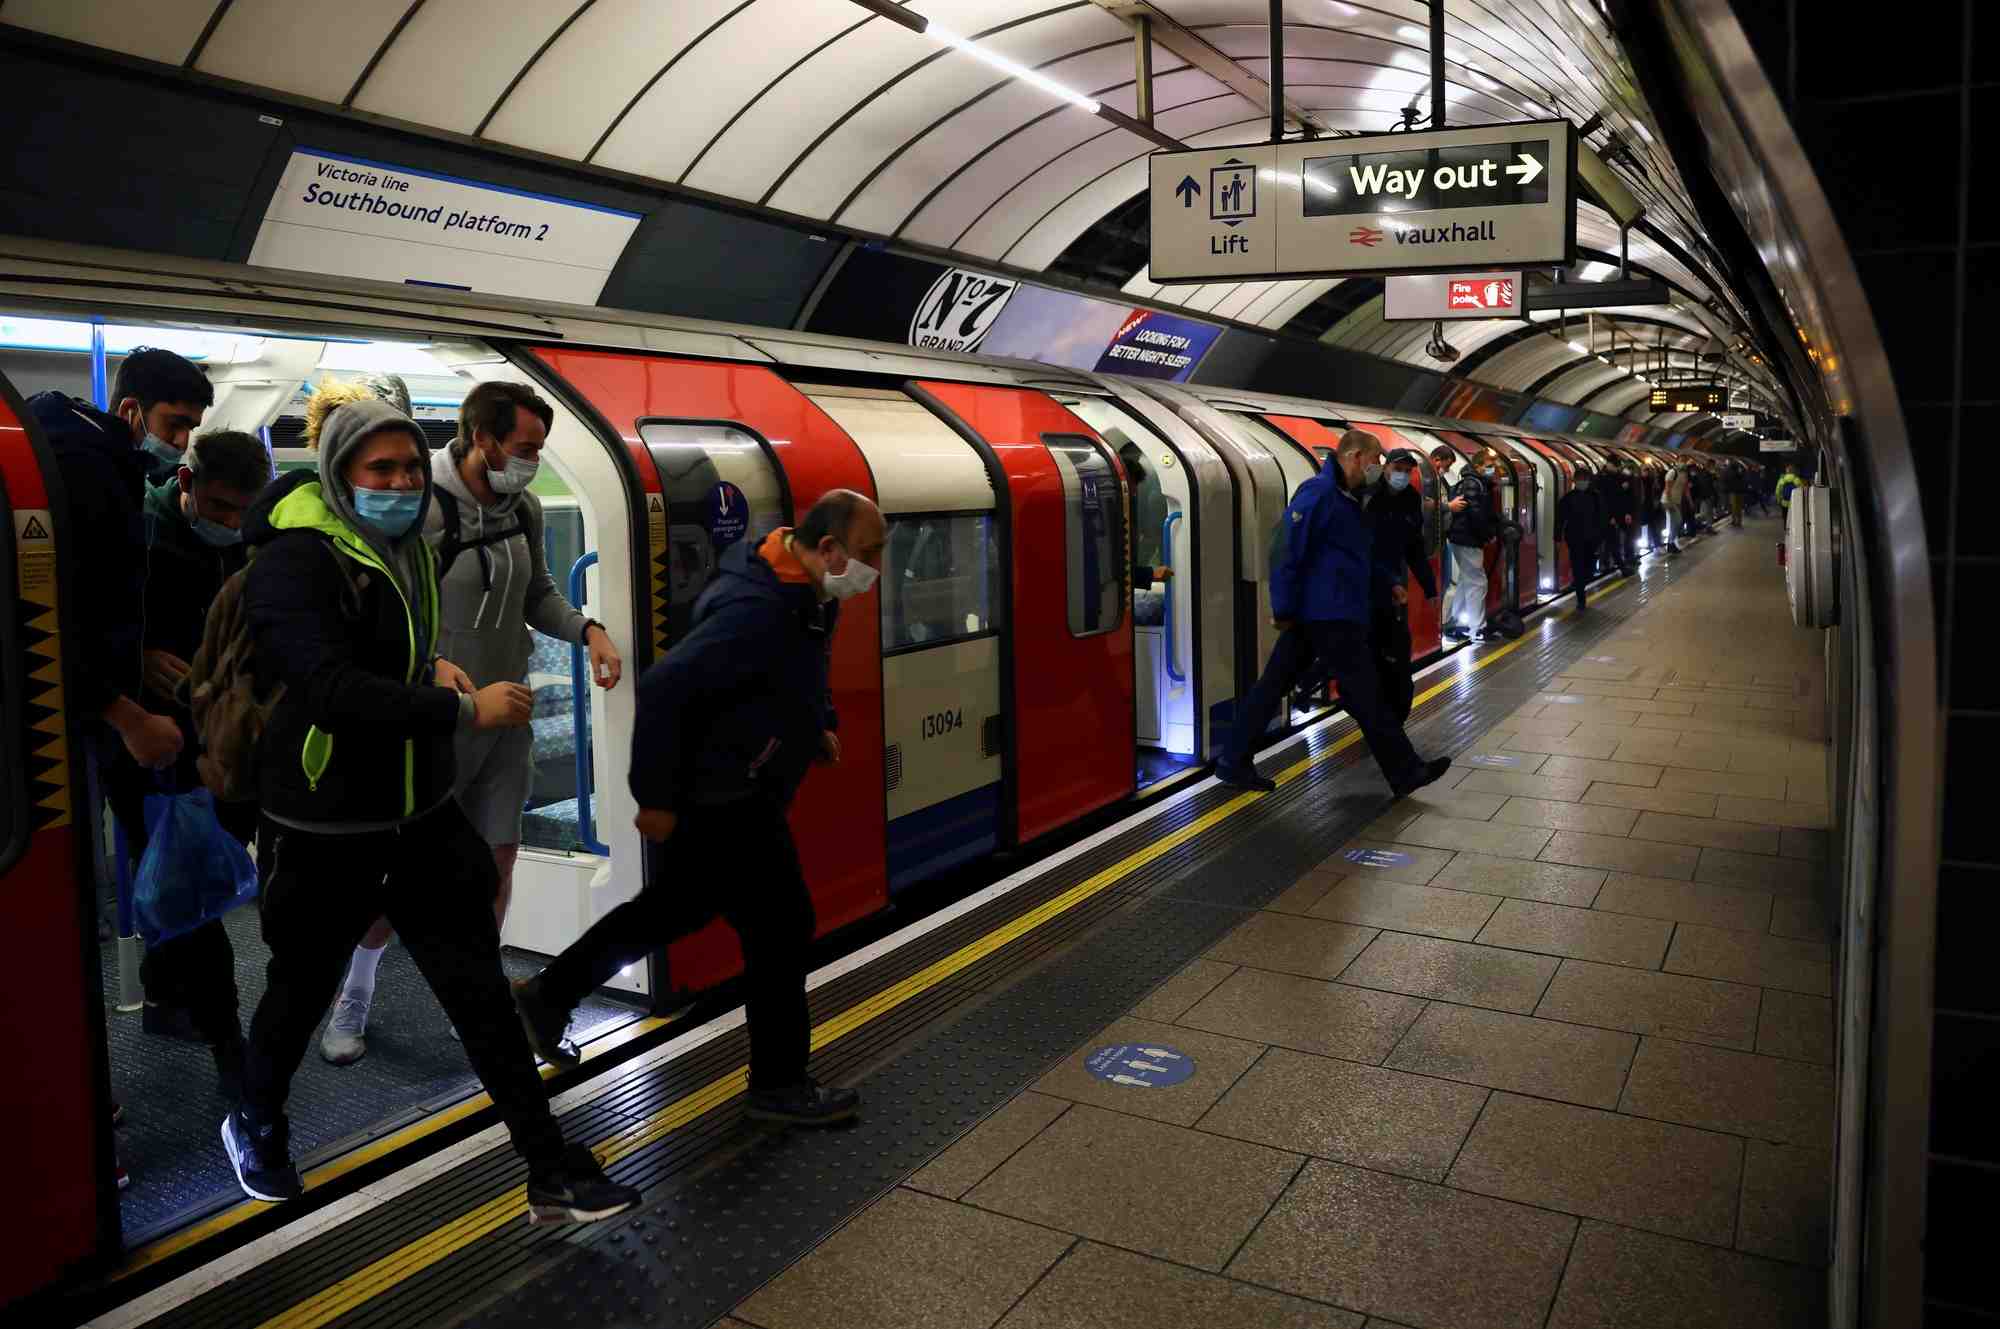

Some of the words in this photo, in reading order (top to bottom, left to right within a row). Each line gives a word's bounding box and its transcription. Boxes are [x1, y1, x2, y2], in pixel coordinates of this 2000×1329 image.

[317, 163, 378, 186] Victoria
[381, 175, 409, 192] line
[1350, 164, 1425, 200] Way
[1433, 159, 1498, 190] out
[303, 183, 444, 223] Southbound
[443, 210, 531, 239] platform
[535, 224, 549, 241] 2
[1211, 234, 1248, 254] Lift
[1453, 283, 1471, 293] Fire
[920, 335, 964, 351] BRAND
[1136, 329, 1171, 346] LOOKING
[1168, 336, 1186, 349] FOR
[1182, 339, 1191, 350] A
[1109, 344, 1141, 361] BETTER
[922, 706, 963, 741] 13094
